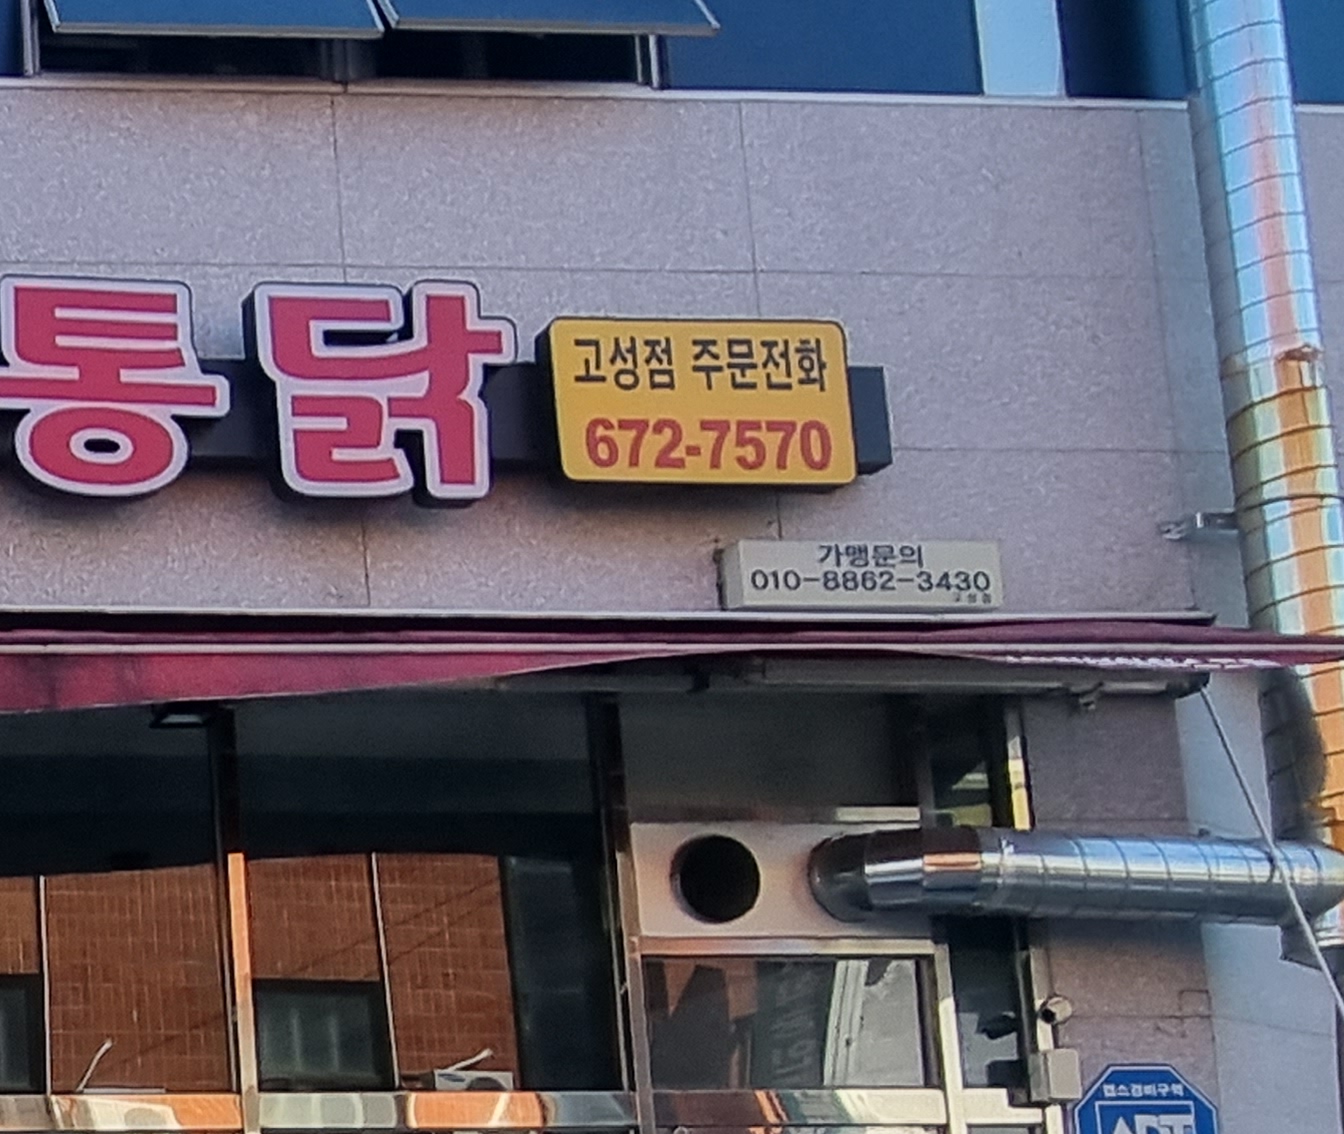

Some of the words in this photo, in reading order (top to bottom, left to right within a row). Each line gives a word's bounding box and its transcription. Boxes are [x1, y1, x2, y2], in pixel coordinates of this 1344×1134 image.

[572, 335, 678, 392] 고성점
[690, 336, 829, 392] 주문전화
[585, 417, 832, 470] 672-7570
[817, 543, 925, 568] 가맹문의
[750, 569, 992, 592] 010-8862-3430
